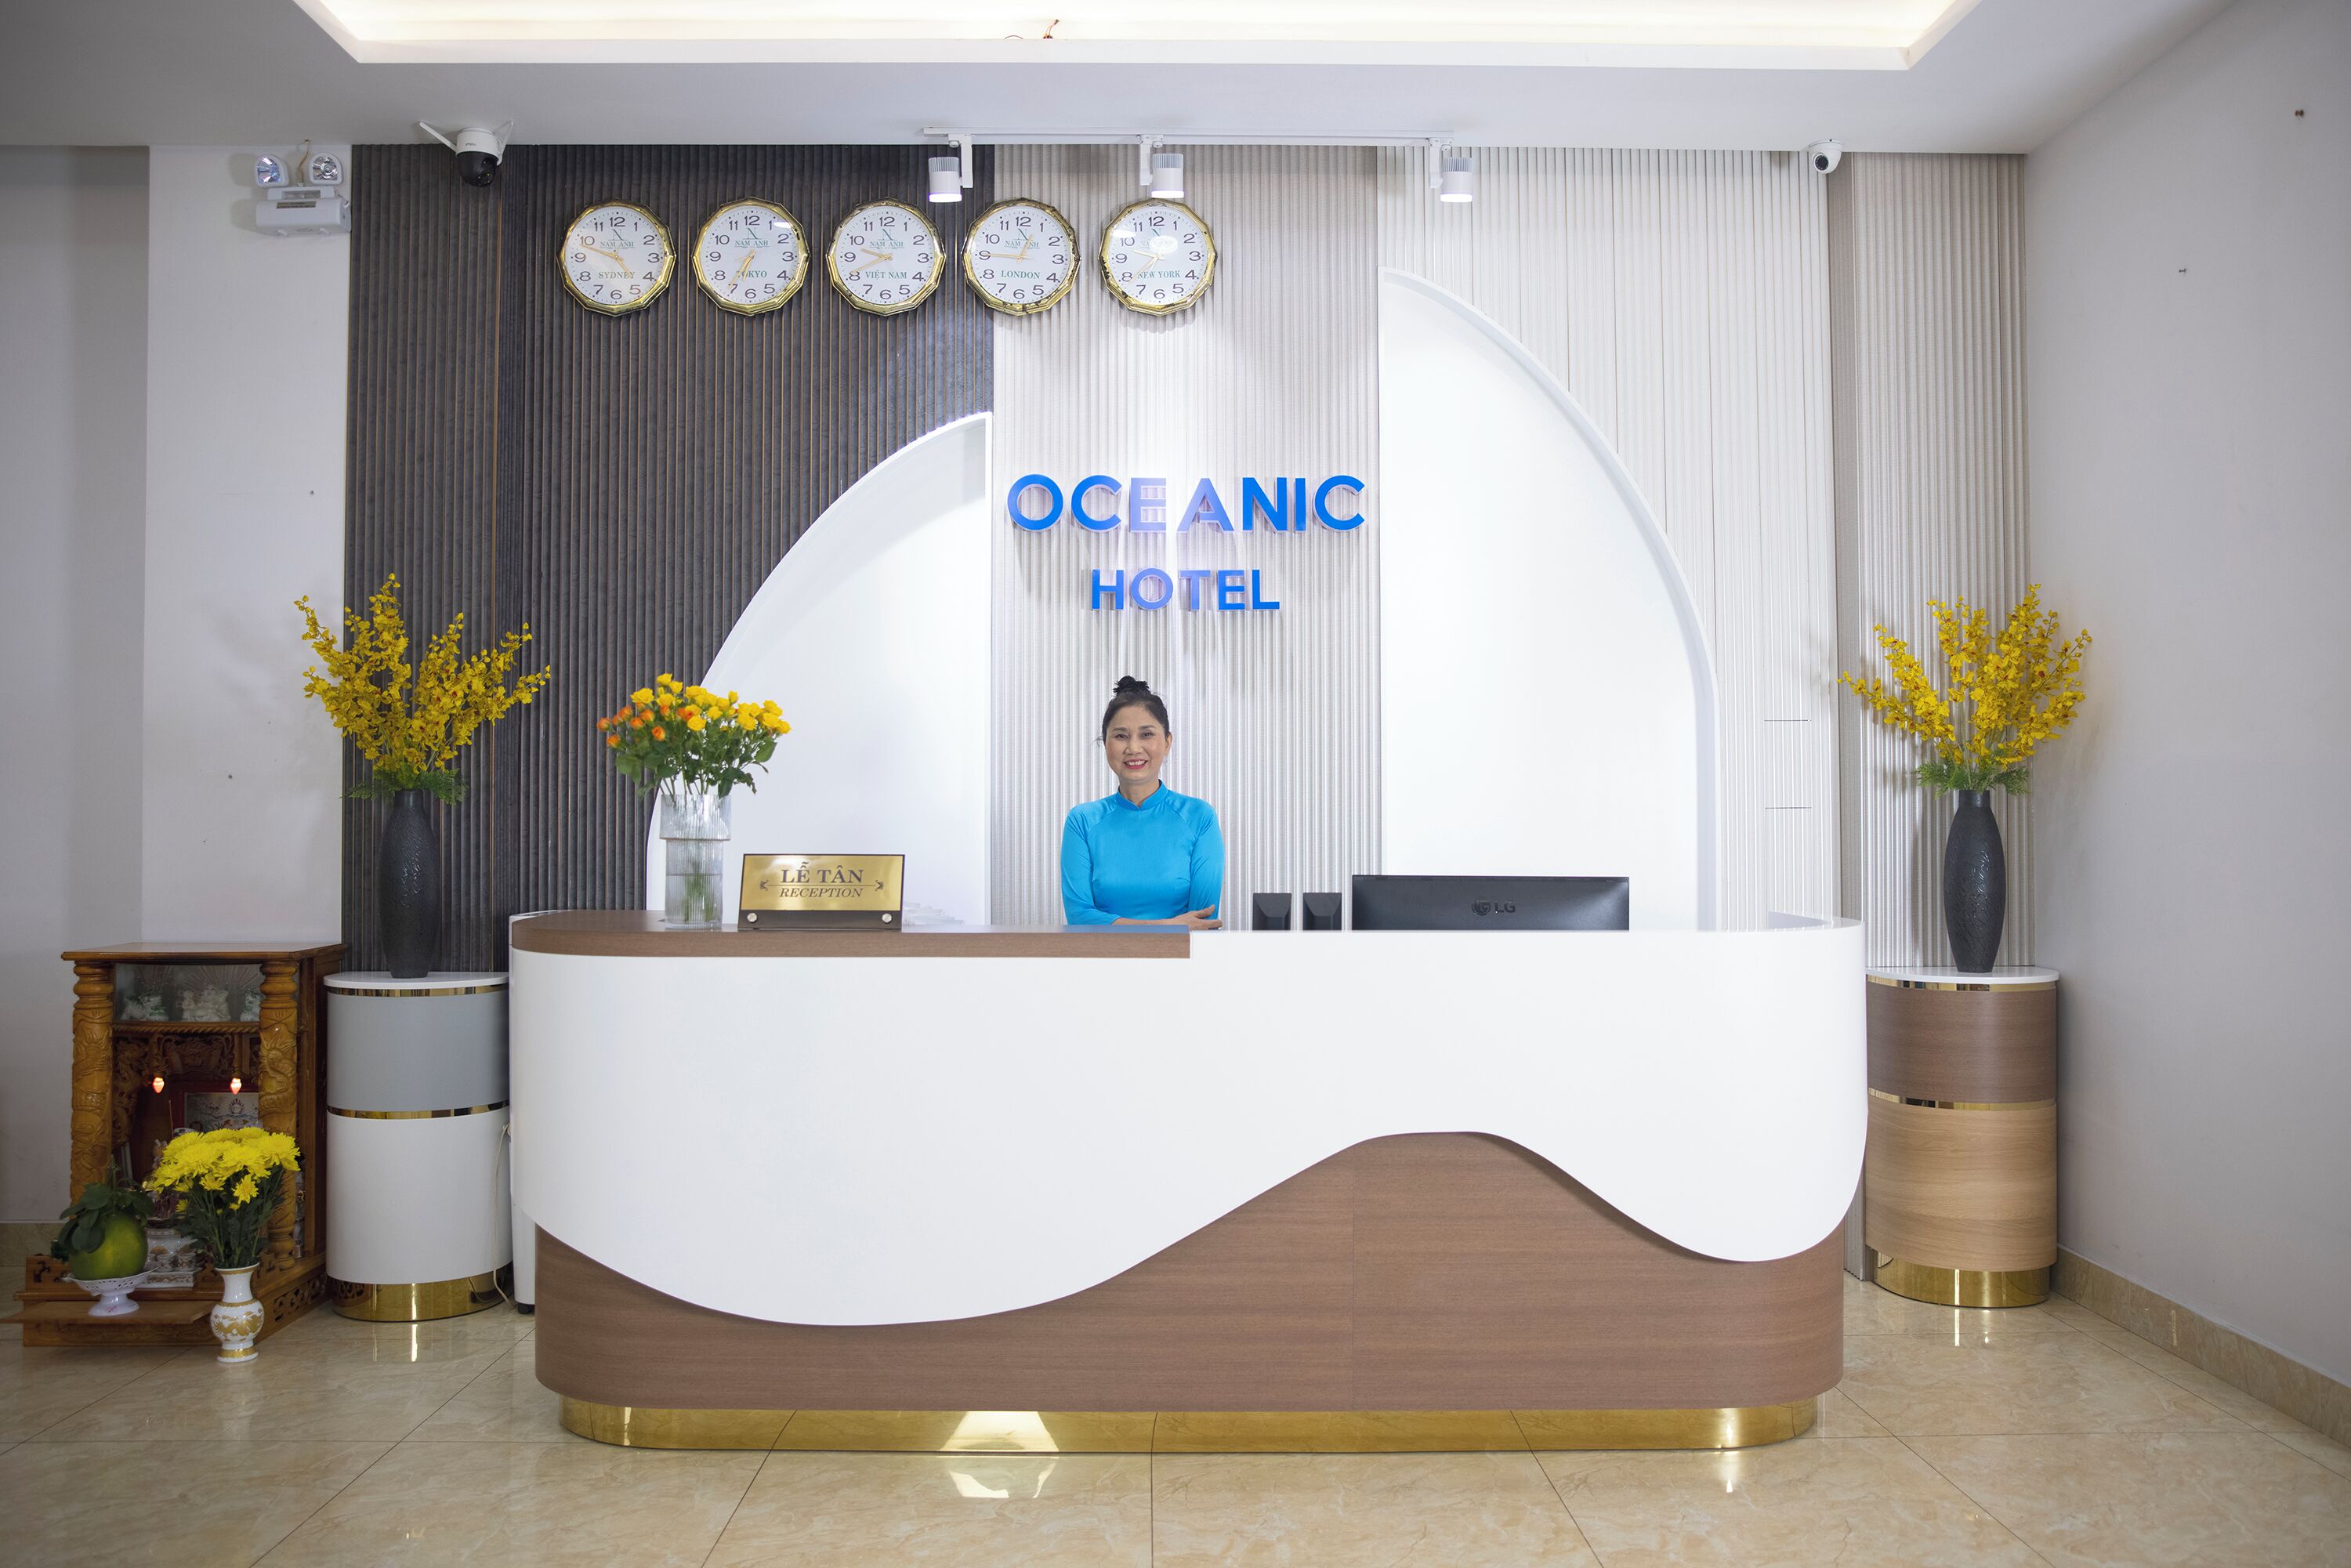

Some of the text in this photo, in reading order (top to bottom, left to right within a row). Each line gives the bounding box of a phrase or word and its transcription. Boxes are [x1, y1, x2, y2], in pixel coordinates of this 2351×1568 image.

[610, 217, 625, 227] 12
[729, 220, 737, 230] 11
[744, 215, 760, 226] 12
[769, 220, 772, 230] 1
[879, 216, 895, 226] 12
[1000, 220, 1009, 230] 11
[1016, 216, 1031, 226] 12
[1148, 216, 1165, 226] 12
[1173, 220, 1177, 230] 1
[595, 222, 603, 231] 11
[634, 222, 637, 231] 1
[864, 221, 873, 231] 11
[904, 222, 907, 231] 1
[1040, 223, 1043, 232] 1
[1134, 222, 1143, 232] 11
[581, 236, 595, 245] 10
[643, 235, 655, 244] 2
[715, 235, 730, 244] 10
[777, 234, 789, 244] 2
[850, 235, 864, 245] 10
[913, 235, 925, 244] 2
[985, 234, 1000, 244] 10
[1049, 236, 1060, 246] 2
[1121, 237, 1135, 247] 10
[1183, 234, 1195, 243] 2
[574, 252, 586, 263] 9
[647, 253, 660, 263] 3
[709, 252, 721, 262] 9
[782, 252, 794, 262] 3
[844, 252, 856, 262] 9
[917, 253, 929, 263] 3
[979, 251, 991, 260] 9
[1052, 254, 1064, 264] 3
[1116, 253, 1127, 263] 9
[1189, 251, 1201, 261] 3
[580, 271, 591, 281] 8
[643, 271, 654, 281] 4
[714, 270, 726, 281] 8
[777, 270, 788, 280] 4
[849, 271, 860, 281] 8
[912, 271, 924, 281] 4
[983, 270, 994, 279] 8
[1046, 273, 1058, 283] 4
[1121, 272, 1132, 281] 8
[1185, 270, 1197, 280] 4
[593, 284, 603, 295] 7
[629, 284, 641, 295] 5
[729, 284, 737, 294] 7
[763, 284, 776, 294] 5
[863, 284, 873, 294] 7
[899, 284, 911, 295] 5
[996, 283, 1006, 293] 7
[1032, 284, 1044, 295] 5
[1136, 284, 1146, 295] 7
[1172, 284, 1184, 293] 5
[610, 289, 622, 299] 6
[744, 288, 756, 299] 6
[880, 289, 891, 299] 6
[1013, 289, 1025, 299] 6
[1154, 289, 1165, 299] 6
[1007, 473, 1366, 533] OCEANIC
[1092, 567, 1280, 611] HOTEL
[781, 861, 864, 884] LỄ TÂN
[780, 889, 863, 897] RECEPTION
[1494, 902, 1516, 913] LG
